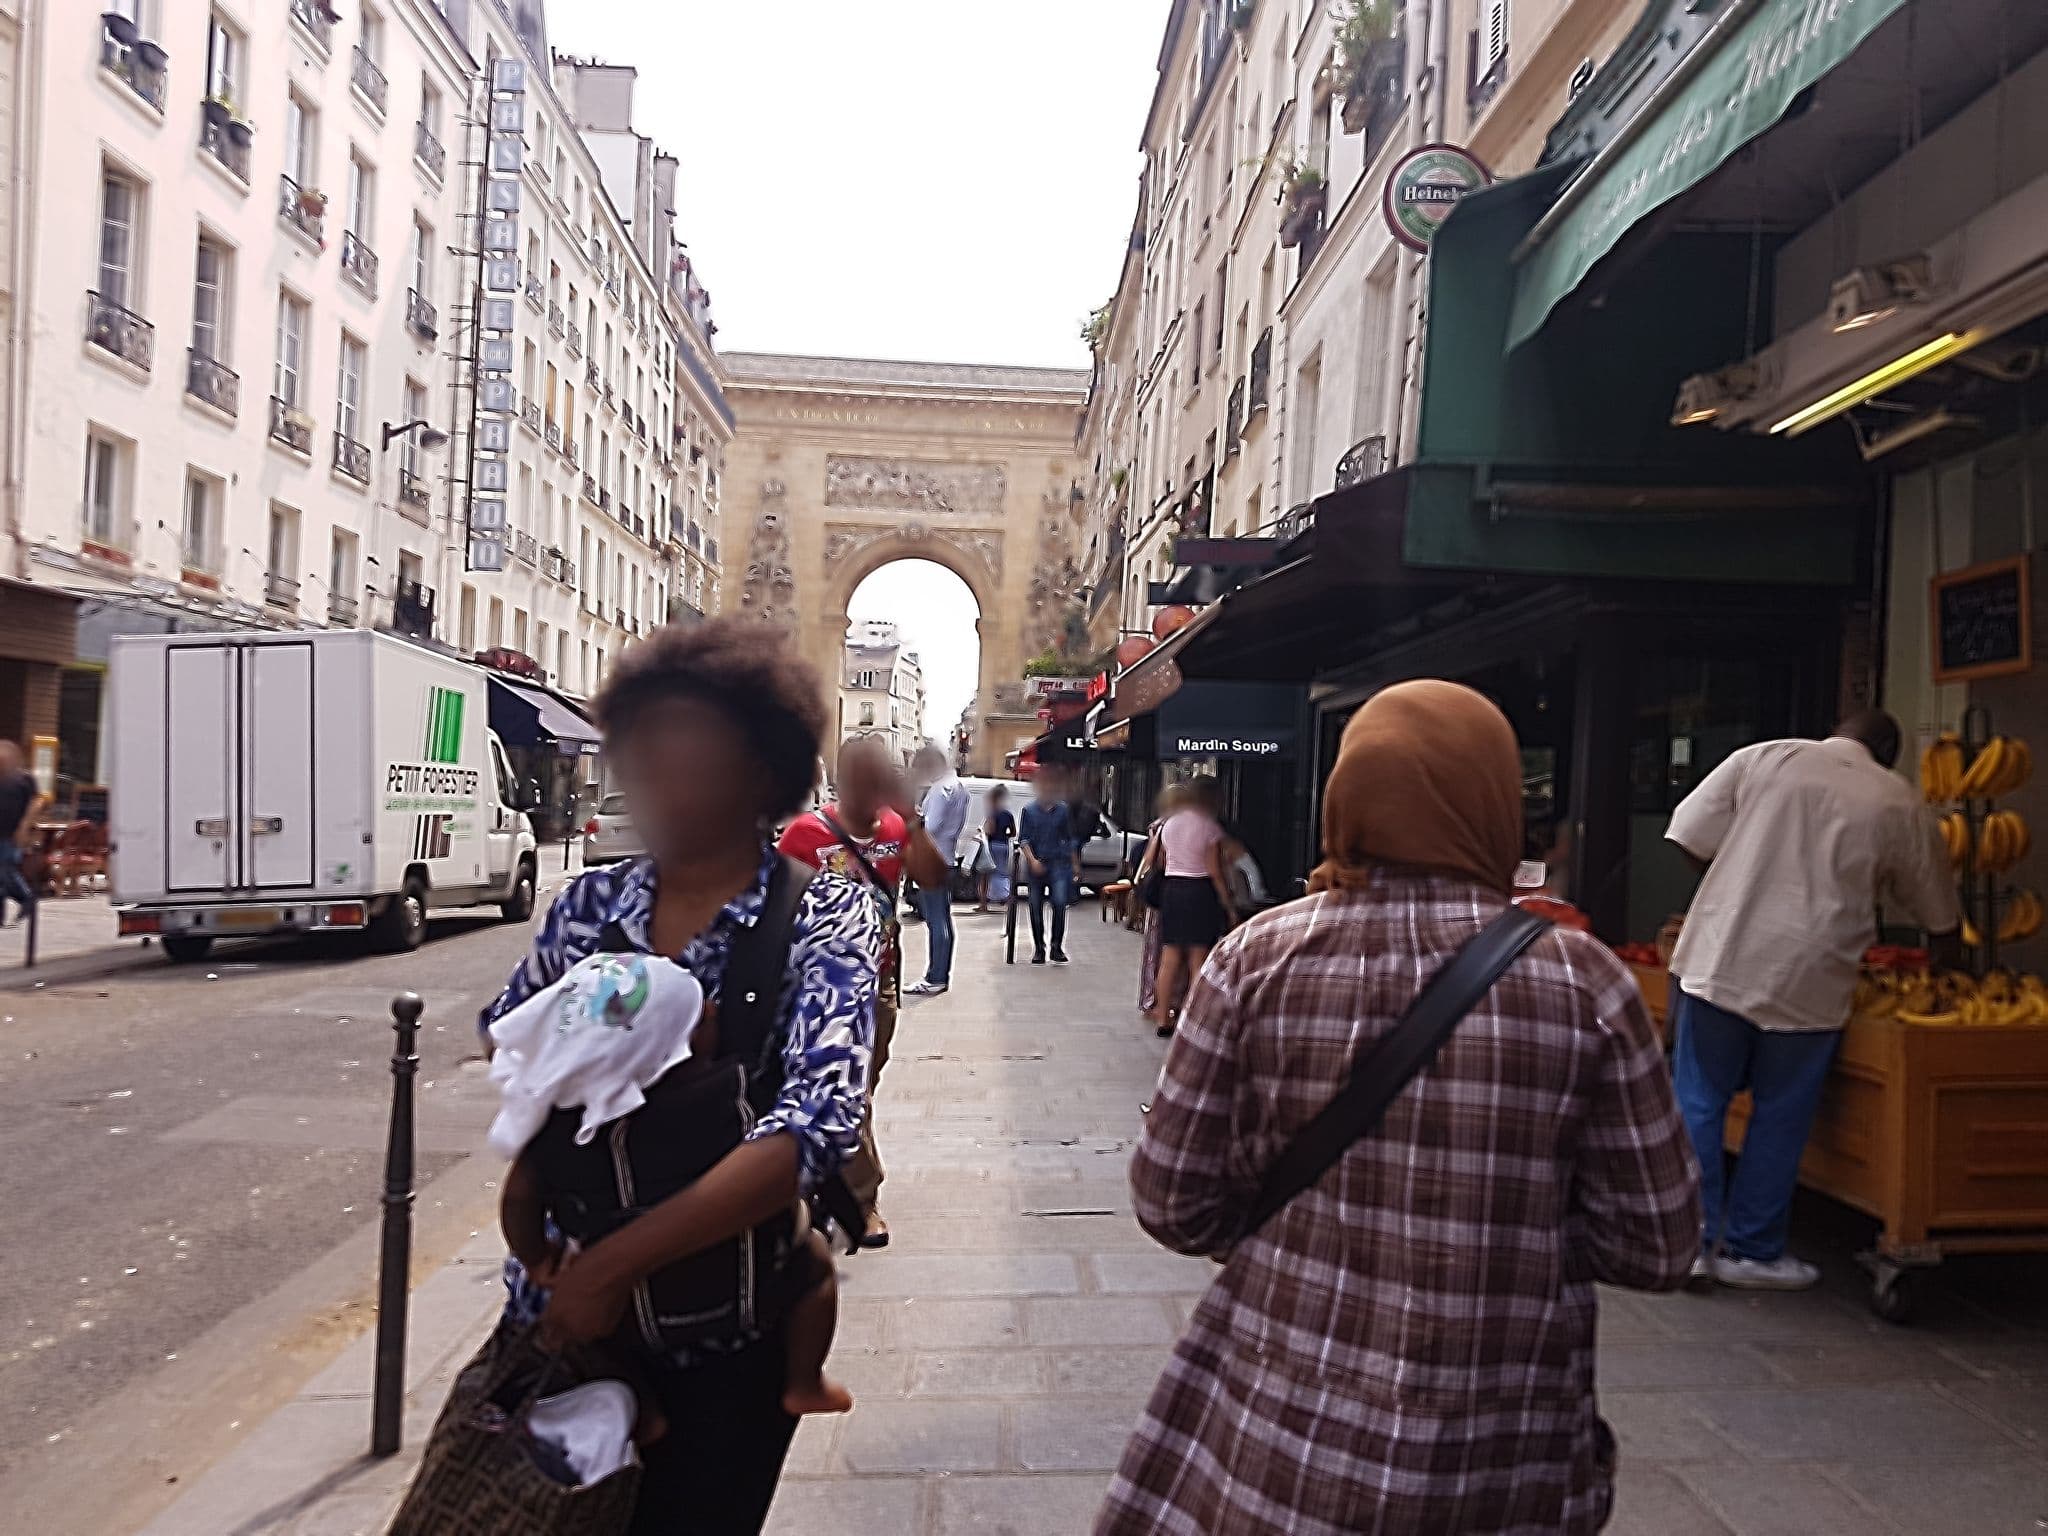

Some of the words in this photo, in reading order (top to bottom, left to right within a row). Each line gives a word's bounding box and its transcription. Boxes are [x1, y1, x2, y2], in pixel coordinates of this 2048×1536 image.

[490, 62, 523, 327] PASSAGE
[1404, 185, 1462, 201] Heinek
[477, 384, 507, 566] PRADO
[1177, 738, 1228, 752] Mardin
[1232, 739, 1279, 755] Soupe
[386, 763, 421, 793] PETIT
[421, 766, 479, 795] FORESTIER
